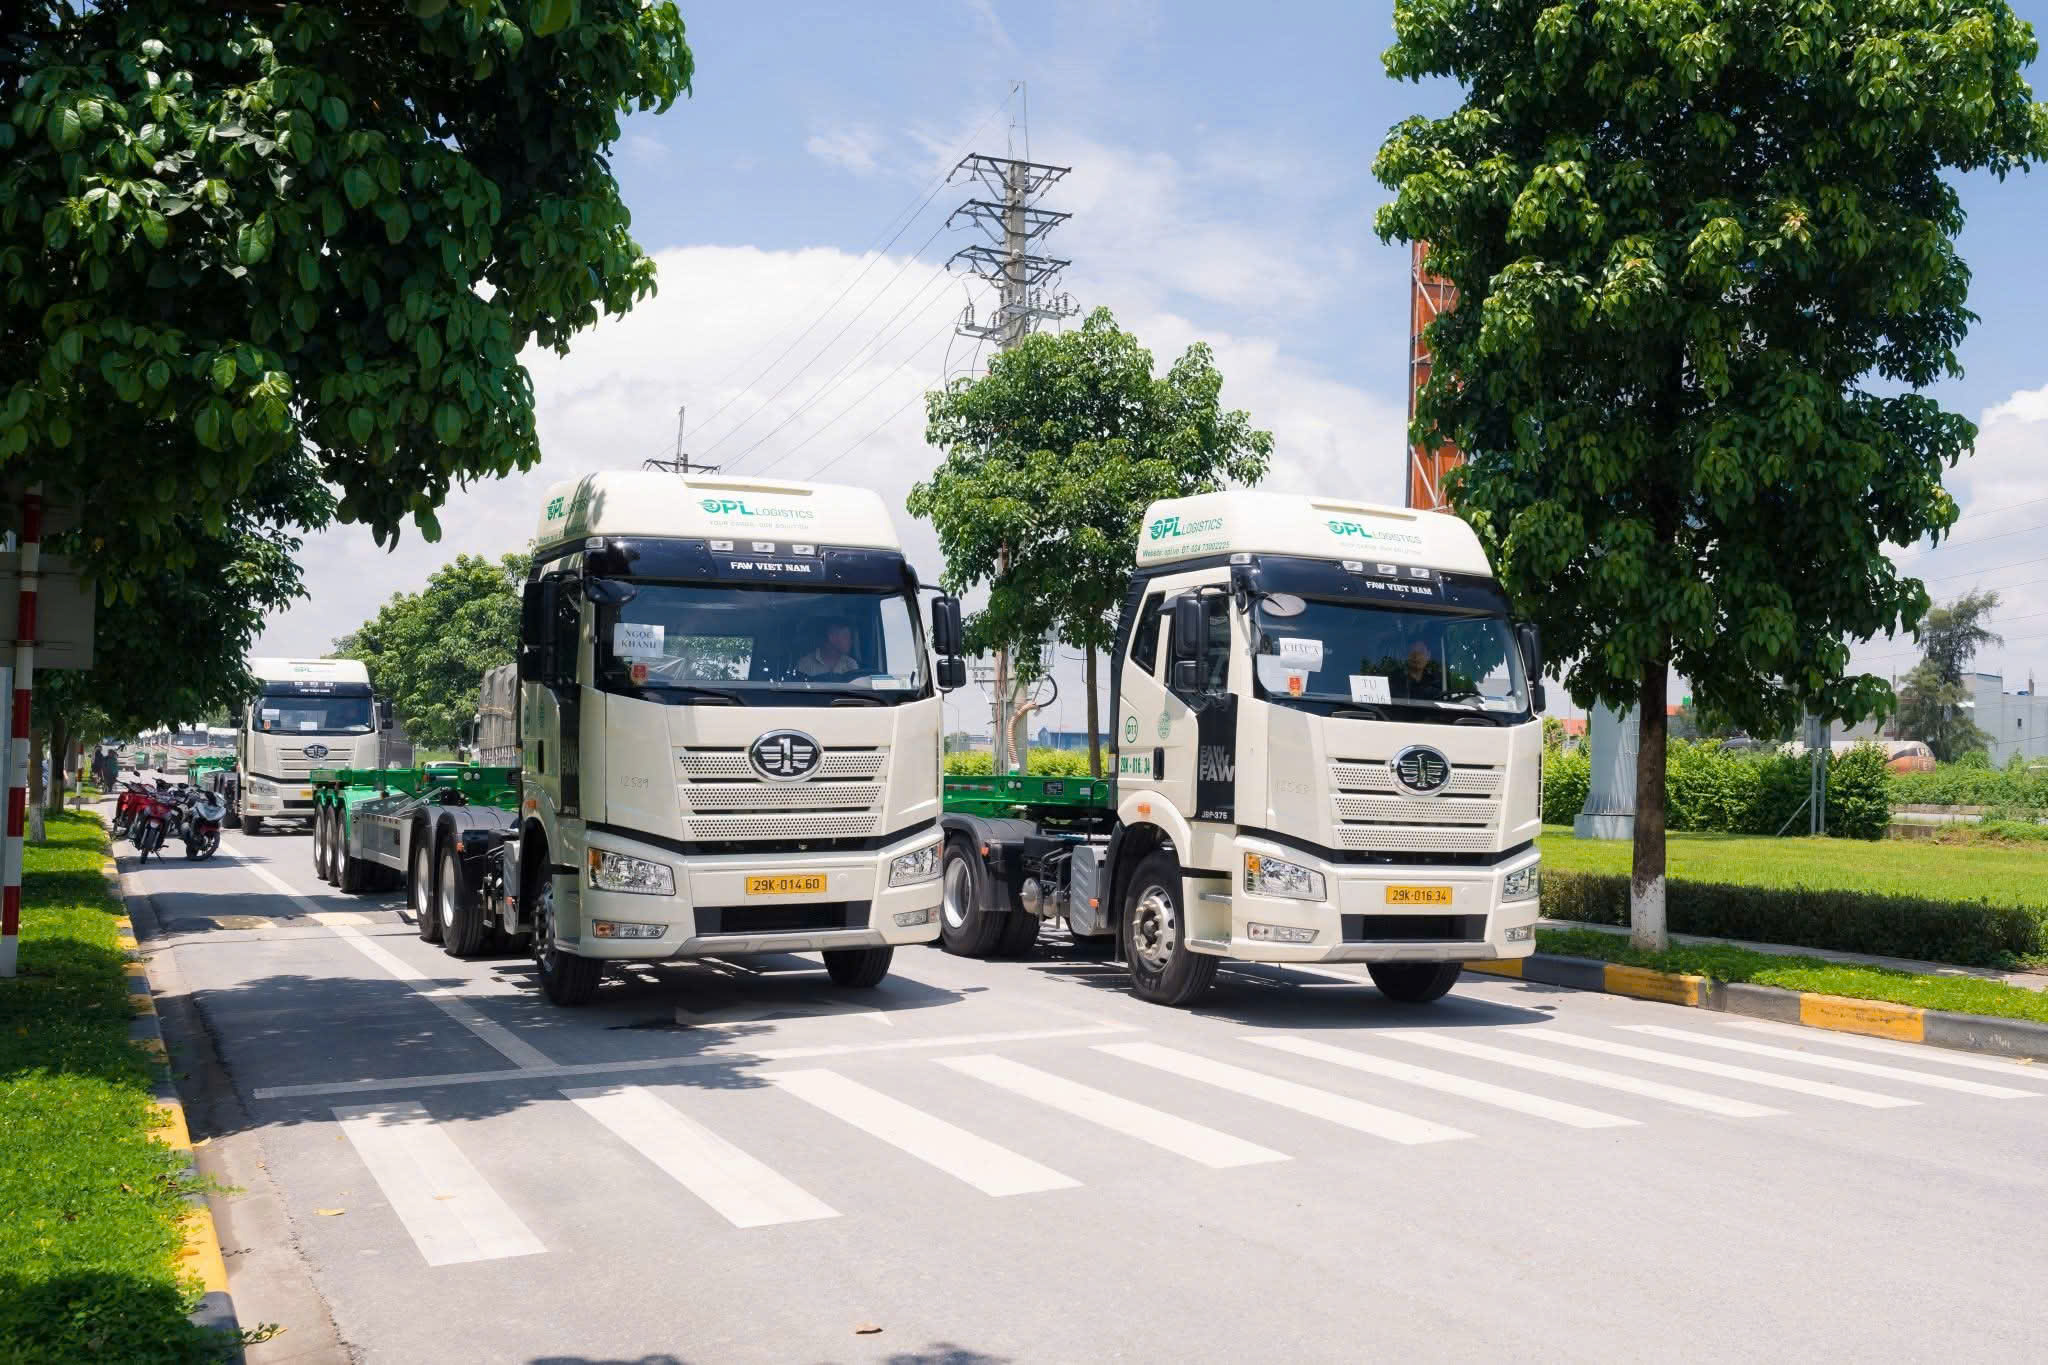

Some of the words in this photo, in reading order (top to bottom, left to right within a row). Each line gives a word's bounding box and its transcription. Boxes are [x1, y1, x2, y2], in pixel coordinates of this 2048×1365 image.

[698, 499, 754, 516] OPL
[755, 507, 814, 519] LOGISTICS
[1148, 516, 1181, 540] OPL
[1182, 518, 1223, 536] LOGISTICS
[1323, 521, 1373, 538] OPL
[730, 561, 754, 570] FAW
[755, 562, 783, 571] VIET
[785, 564, 811, 573] NAM
[1365, 581, 1385, 590] FAW
[1386, 583, 1410, 593] VIET
[1412, 586, 1433, 596] NAM
[1200, 765, 1236, 782] FAW
